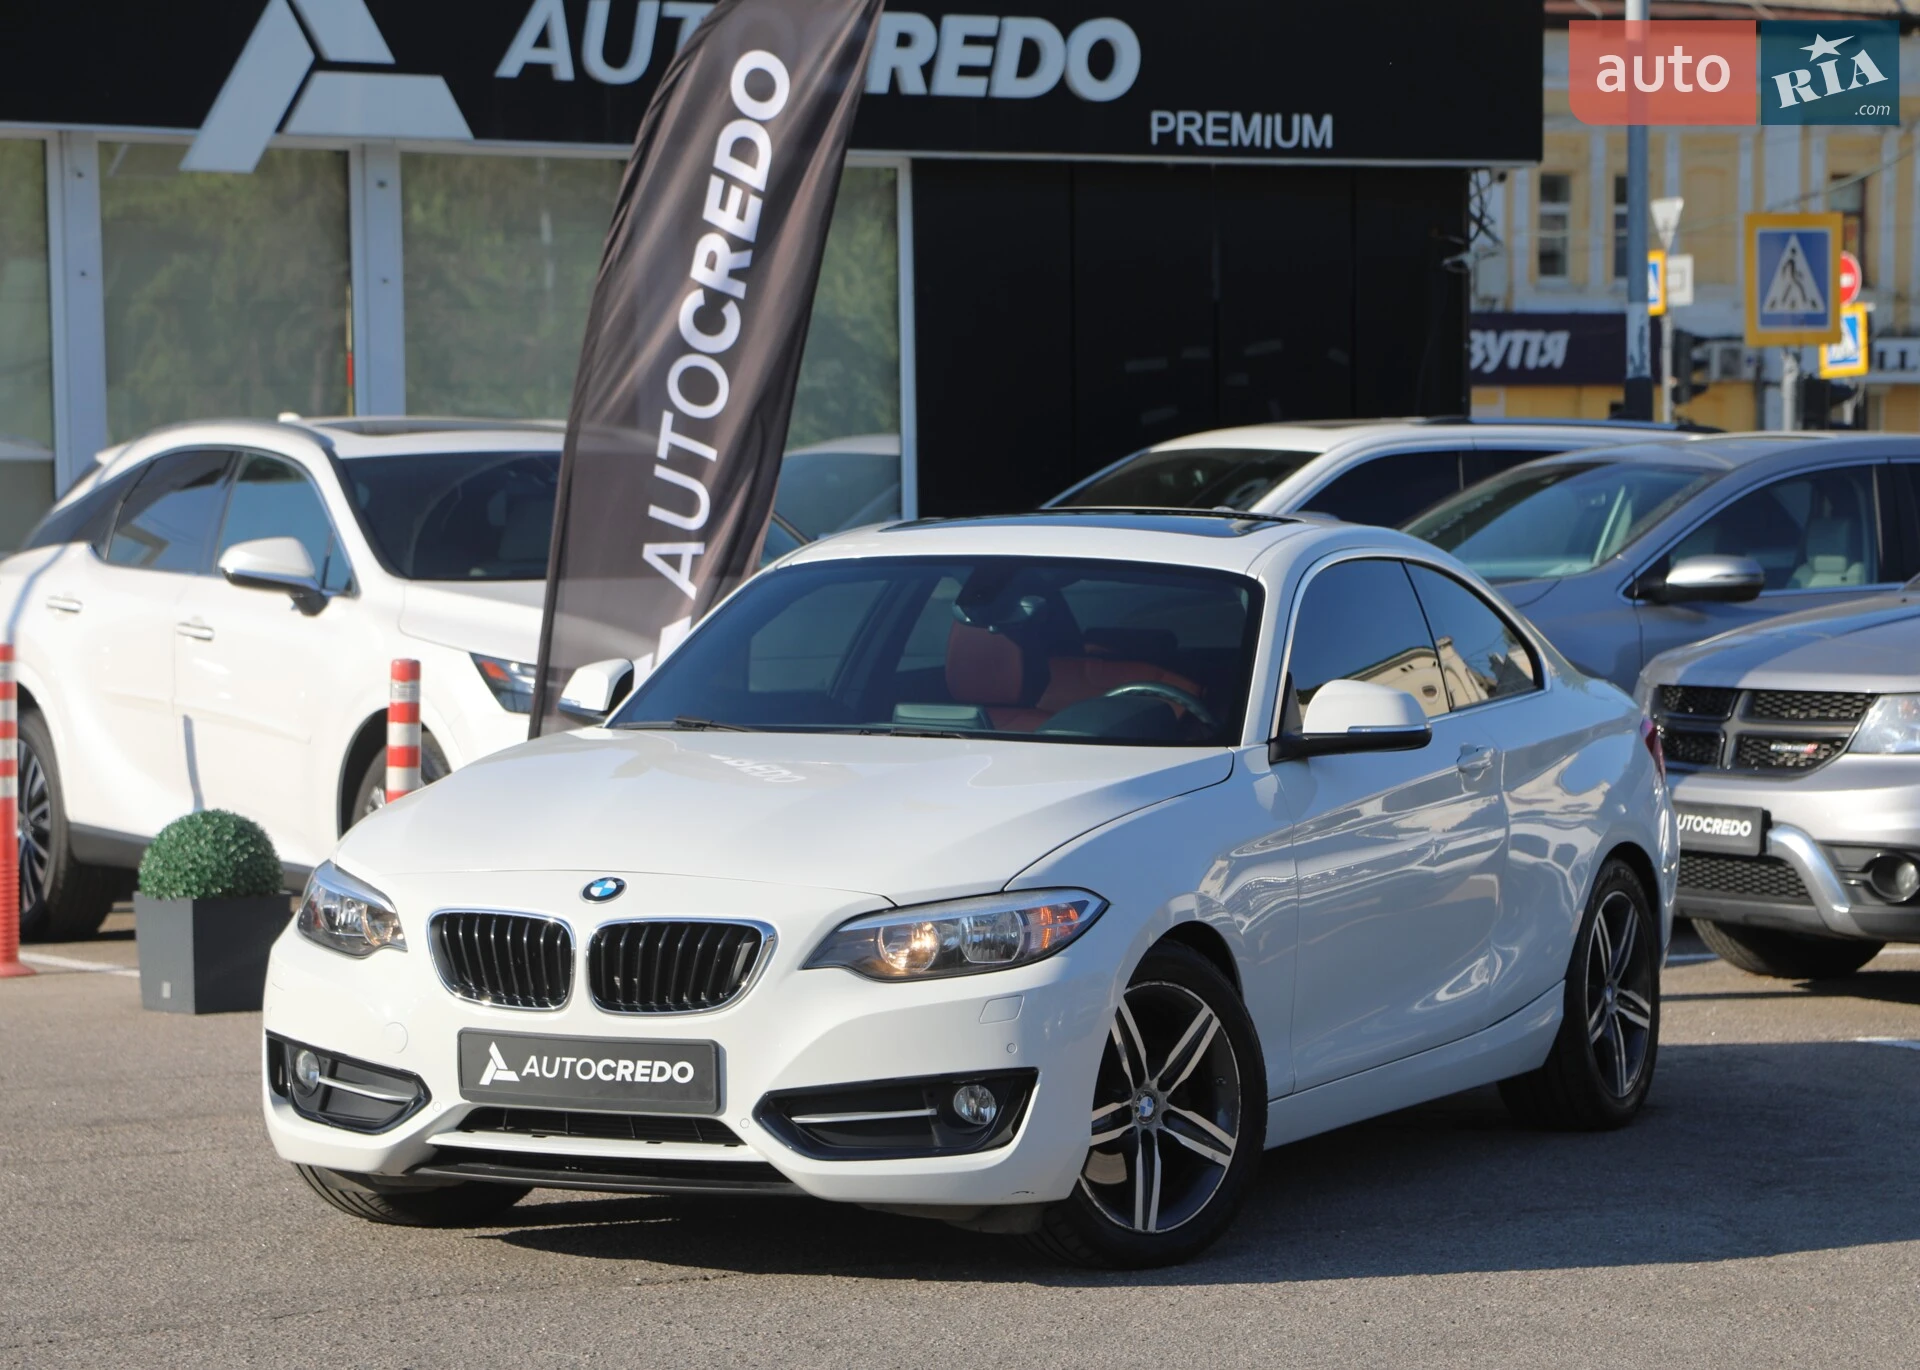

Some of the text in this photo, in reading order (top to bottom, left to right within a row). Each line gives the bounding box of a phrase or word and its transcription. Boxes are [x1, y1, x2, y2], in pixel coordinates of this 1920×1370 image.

[494, 0, 1142, 102] AUTREDO
[1150, 110, 1334, 149] PREMIUM
[642, 49, 791, 600] AUTOCREDO
[1469, 328, 1571, 374] ЗУТТЯ
[1676, 813, 1752, 837] UTOCREDO
[521, 1055, 695, 1084] AUTOCREDO
